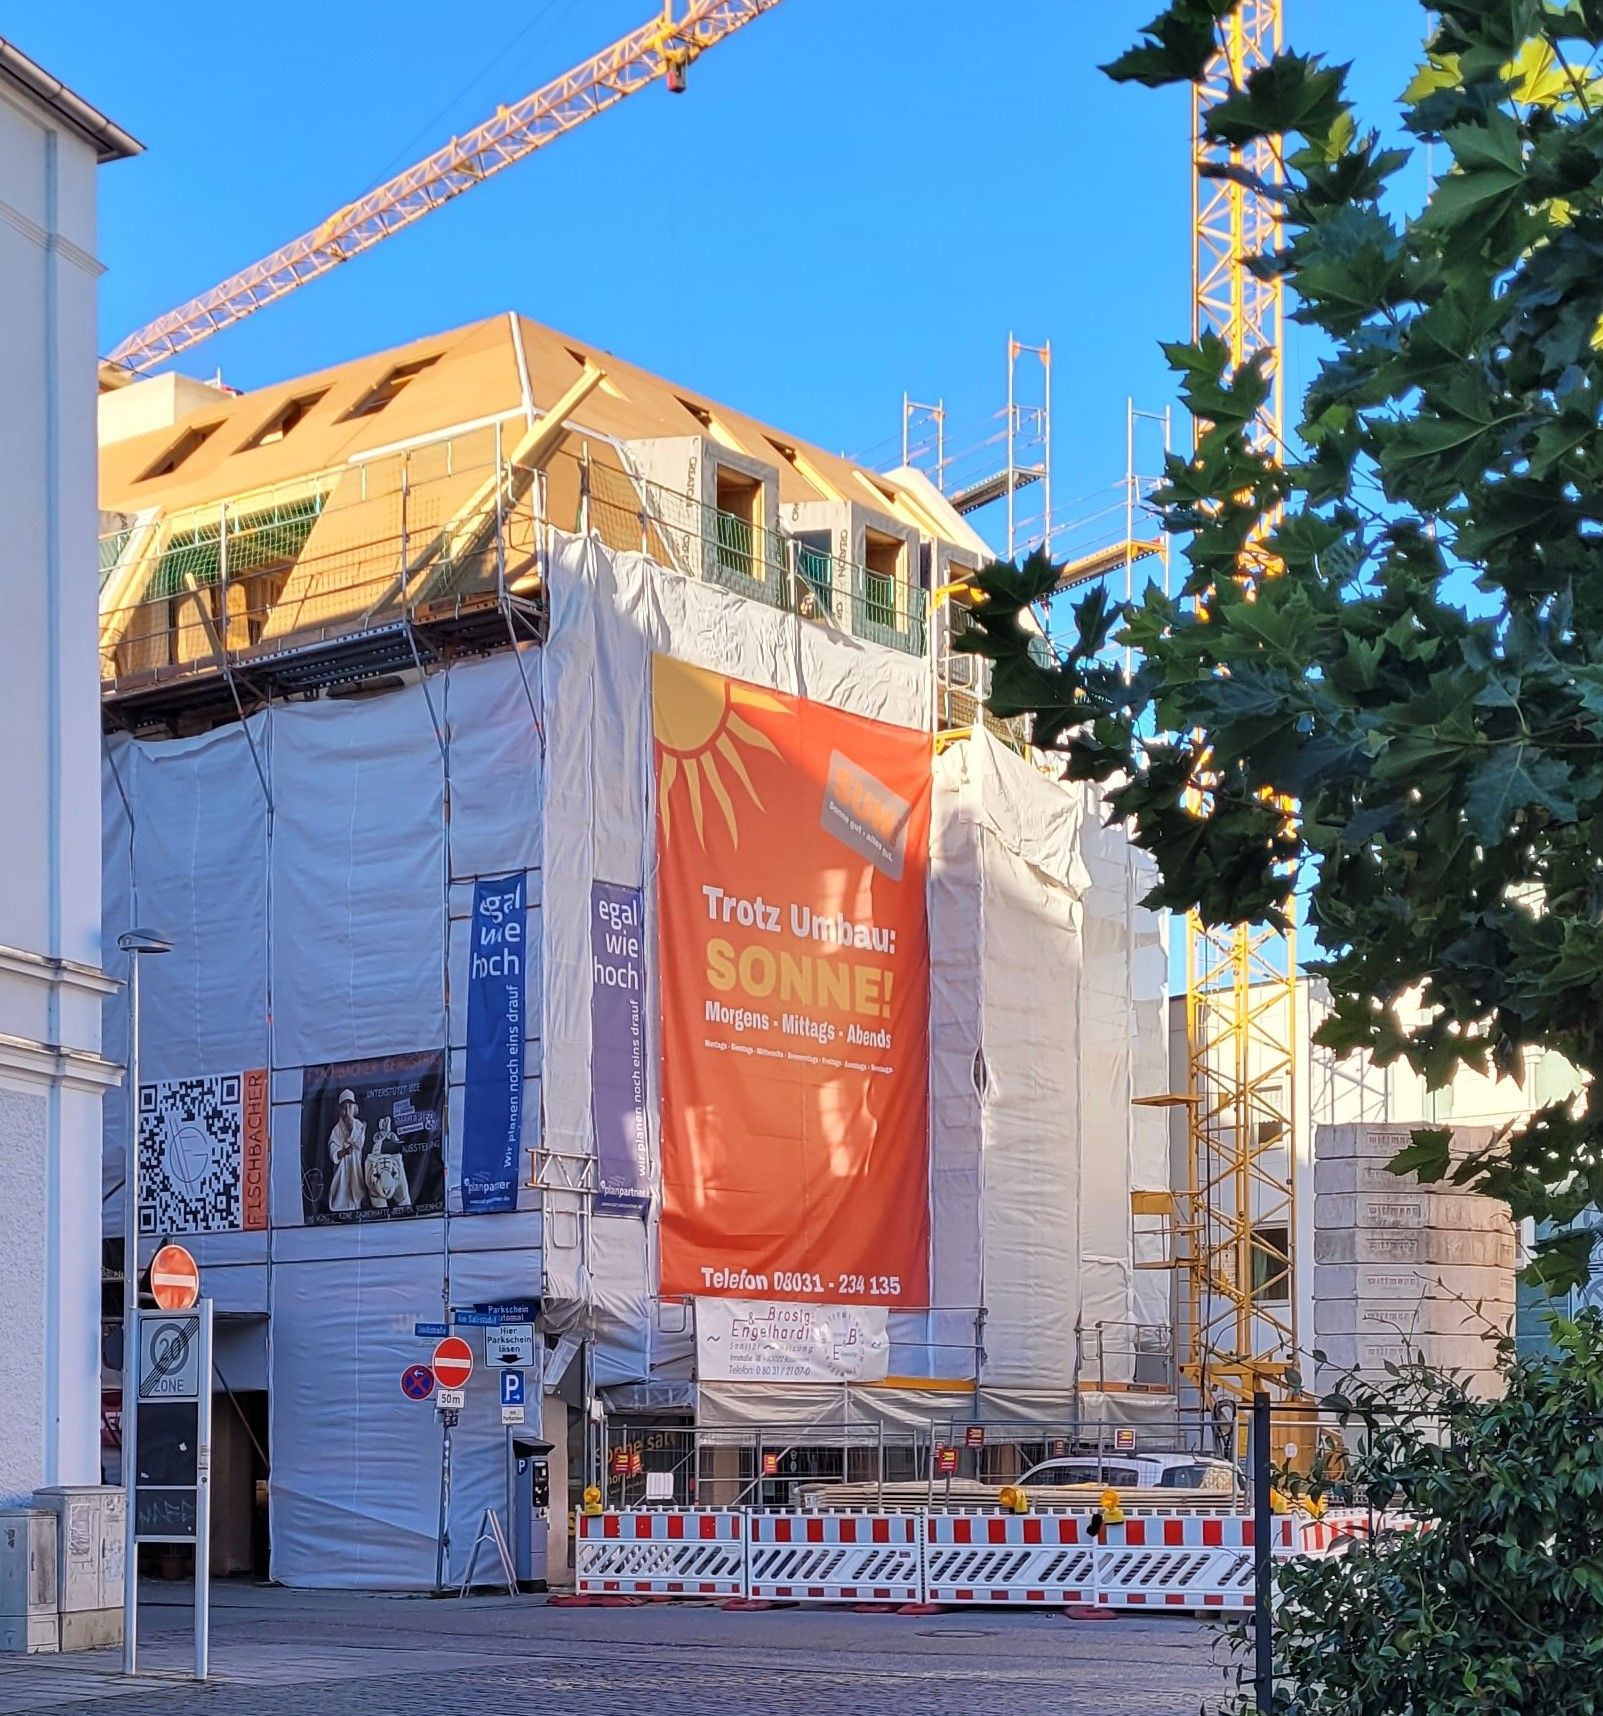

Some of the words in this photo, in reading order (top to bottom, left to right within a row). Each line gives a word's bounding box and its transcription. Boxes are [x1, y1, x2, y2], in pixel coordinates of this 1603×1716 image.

[838, 529, 848, 578] CREATON
[599, 899, 638, 930] egal
[702, 885, 782, 932] Trotz
[790, 903, 896, 954] Umbau:
[605, 930, 639, 958] wie
[594, 955, 639, 990] hoch
[706, 938, 894, 1019] SONNE!
[506, 985, 519, 1022] drauf
[629, 999, 640, 1035] drauf
[705, 1000, 769, 1031] Morgens
[782, 1013, 835, 1044] Mittags
[847, 1023, 891, 1049] Abends
[506, 1026, 519, 1054] eins
[631, 1042, 641, 1067] eins
[506, 1059, 519, 1091] noch
[632, 1070, 642, 1103] noch
[505, 1095, 518, 1143] planen
[634, 1106, 645, 1153] planen
[247, 1074, 263, 1226] FISCHBACHER
[638, 1155, 647, 1177] wir
[700, 1266, 769, 1290] Telefon
[773, 1271, 824, 1293] 08031
[838, 1273, 865, 1295] 234
[869, 1276, 901, 1295] 135
[488, 1304, 529, 1314] Parkschein
[768, 1306, 811, 1325] Brosig
[487, 1336, 532, 1344] Parkschein
[500, 1327, 517, 1335] Hier
[731, 1320, 811, 1341] Engelhardt
[154, 1378, 184, 1392] ZONE
[505, 1374, 519, 1401] P
[518, 1459, 526, 1472] P
